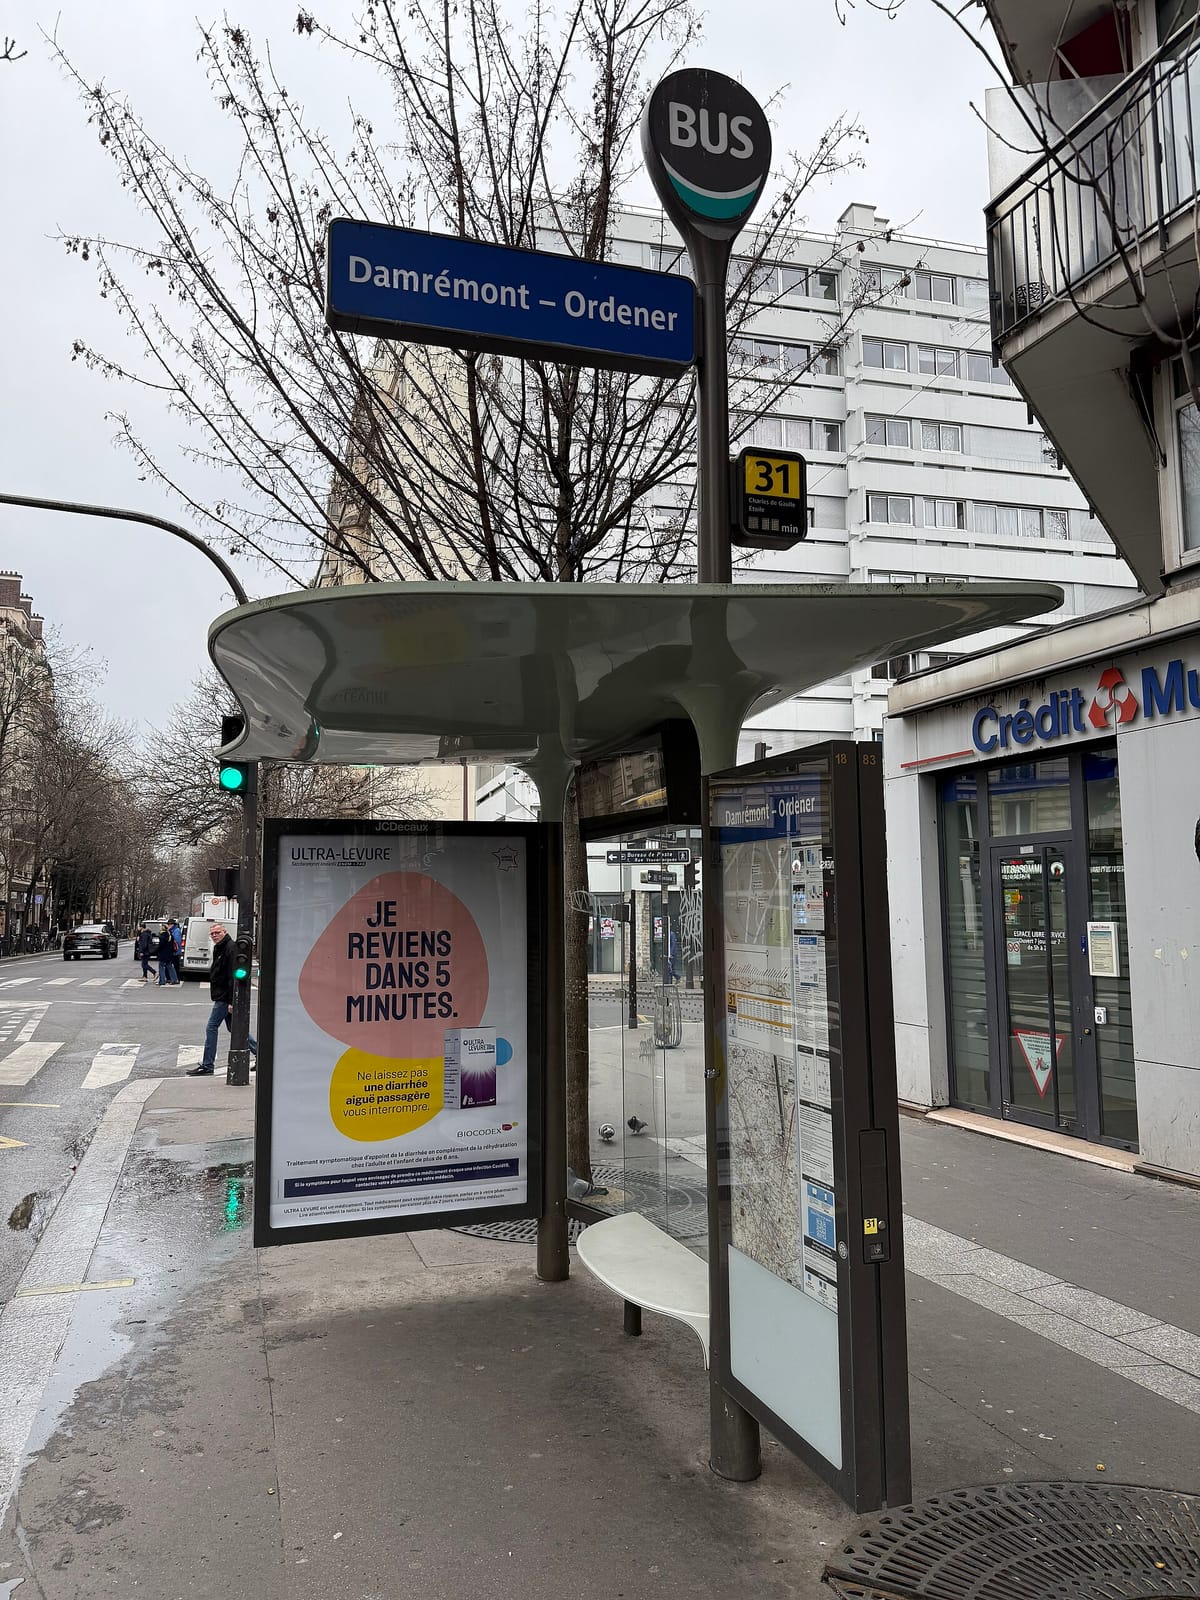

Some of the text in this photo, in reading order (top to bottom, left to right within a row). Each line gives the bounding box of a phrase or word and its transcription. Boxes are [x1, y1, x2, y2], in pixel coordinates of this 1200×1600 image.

[669, 101, 754, 159] BUS
[349, 255, 530, 310] Damrémont
[564, 290, 678, 332] Ordener
[755, 460, 790, 494] 31
[748, 497, 770, 505] Charles
[778, 500, 796, 508] Gaulle
[781, 524, 799, 534] min
[972, 687, 1086, 752] Crédit
[835, 752, 848, 765] 18
[862, 754, 876, 765] 83
[725, 802, 770, 826] Damrémont
[778, 796, 816, 818] Ordener
[375, 821, 429, 832] JCDecaux
[291, 847, 391, 861] ULTRA-LEVURE
[366, 900, 397, 928] JE
[1031, 930, 1046, 938] LIBRE
[347, 930, 452, 960] REVIENS
[365, 960, 451, 990] DANS 5
[728, 991, 736, 1005] 31
[345, 990, 459, 1023] MINUTES.
[357, 1069, 429, 1081] Ne laissez pas
[364, 1079, 429, 1092] une diarrhée
[345, 1093, 375, 1107] aiguë
[377, 1090, 431, 1105] passagère
[342, 1103, 431, 1117] vous interrompre.
[457, 1128, 502, 1138] BIOCODEX
[319, 1155, 363, 1165] symptomatique
[435, 1146, 469, 1154] complément
[483, 1142, 518, 1150] réhydratation
[422, 1155, 435, 1163] plus
[866, 1219, 875, 1229] 31
